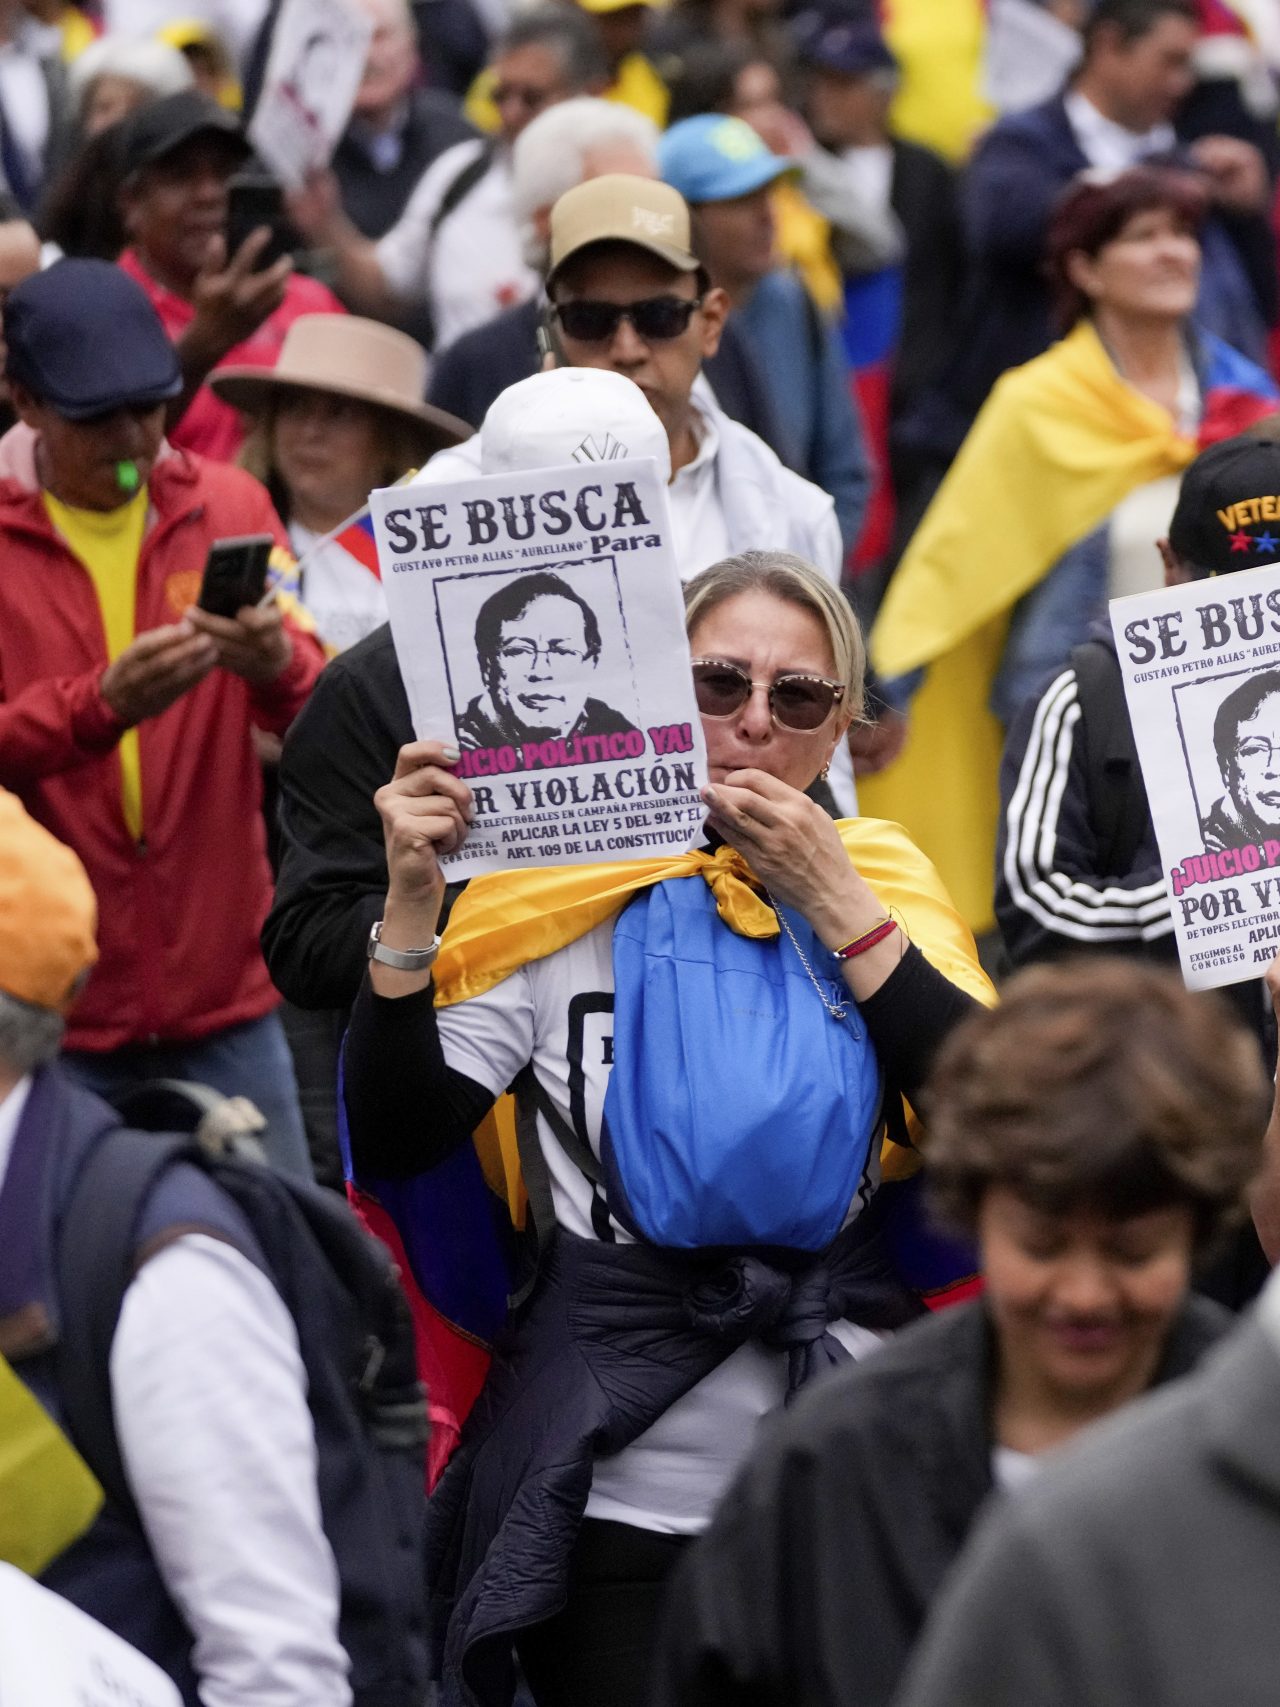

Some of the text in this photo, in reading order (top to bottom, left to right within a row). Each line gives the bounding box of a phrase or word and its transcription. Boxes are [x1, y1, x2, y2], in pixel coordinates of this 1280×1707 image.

[385, 482, 650, 553] SE BUSCA
[591, 533, 661, 554] Para
[392, 561, 442, 573] GUSTAVO
[445, 555, 479, 567] PETRO
[482, 550, 513, 561] ALIAS
[1124, 611, 1187, 665] SE
[1134, 666, 1179, 683] GUSTAVO
[1182, 658, 1214, 674] PETRO
[1216, 651, 1245, 666] ALIAS
[522, 730, 645, 770] POLÍTICO
[648, 722, 694, 755] YA!
[506, 758, 697, 810] VIOLACIÓN
[562, 809, 575, 819] EN
[578, 802, 628, 817] CAMPAÑA
[630, 795, 703, 811] PRESIDENCIAL
[501, 808, 702, 842] APLICAR LA LEY 5 DEL 92 Y EL
[442, 849, 498, 865] CONGRESO
[507, 846, 536, 859] ART.
[538, 842, 561, 856] 109
[565, 841, 584, 855] DE
[586, 837, 604, 852] LA
[1171, 844, 1260, 896] ¡JUICIO
[1179, 887, 1247, 926] POR
[1187, 930, 1199, 940] DE
[1200, 923, 1229, 937] TOPES
[1190, 944, 1243, 963] EXIGIMOS AL
[1192, 953, 1245, 971] CONGRESO
